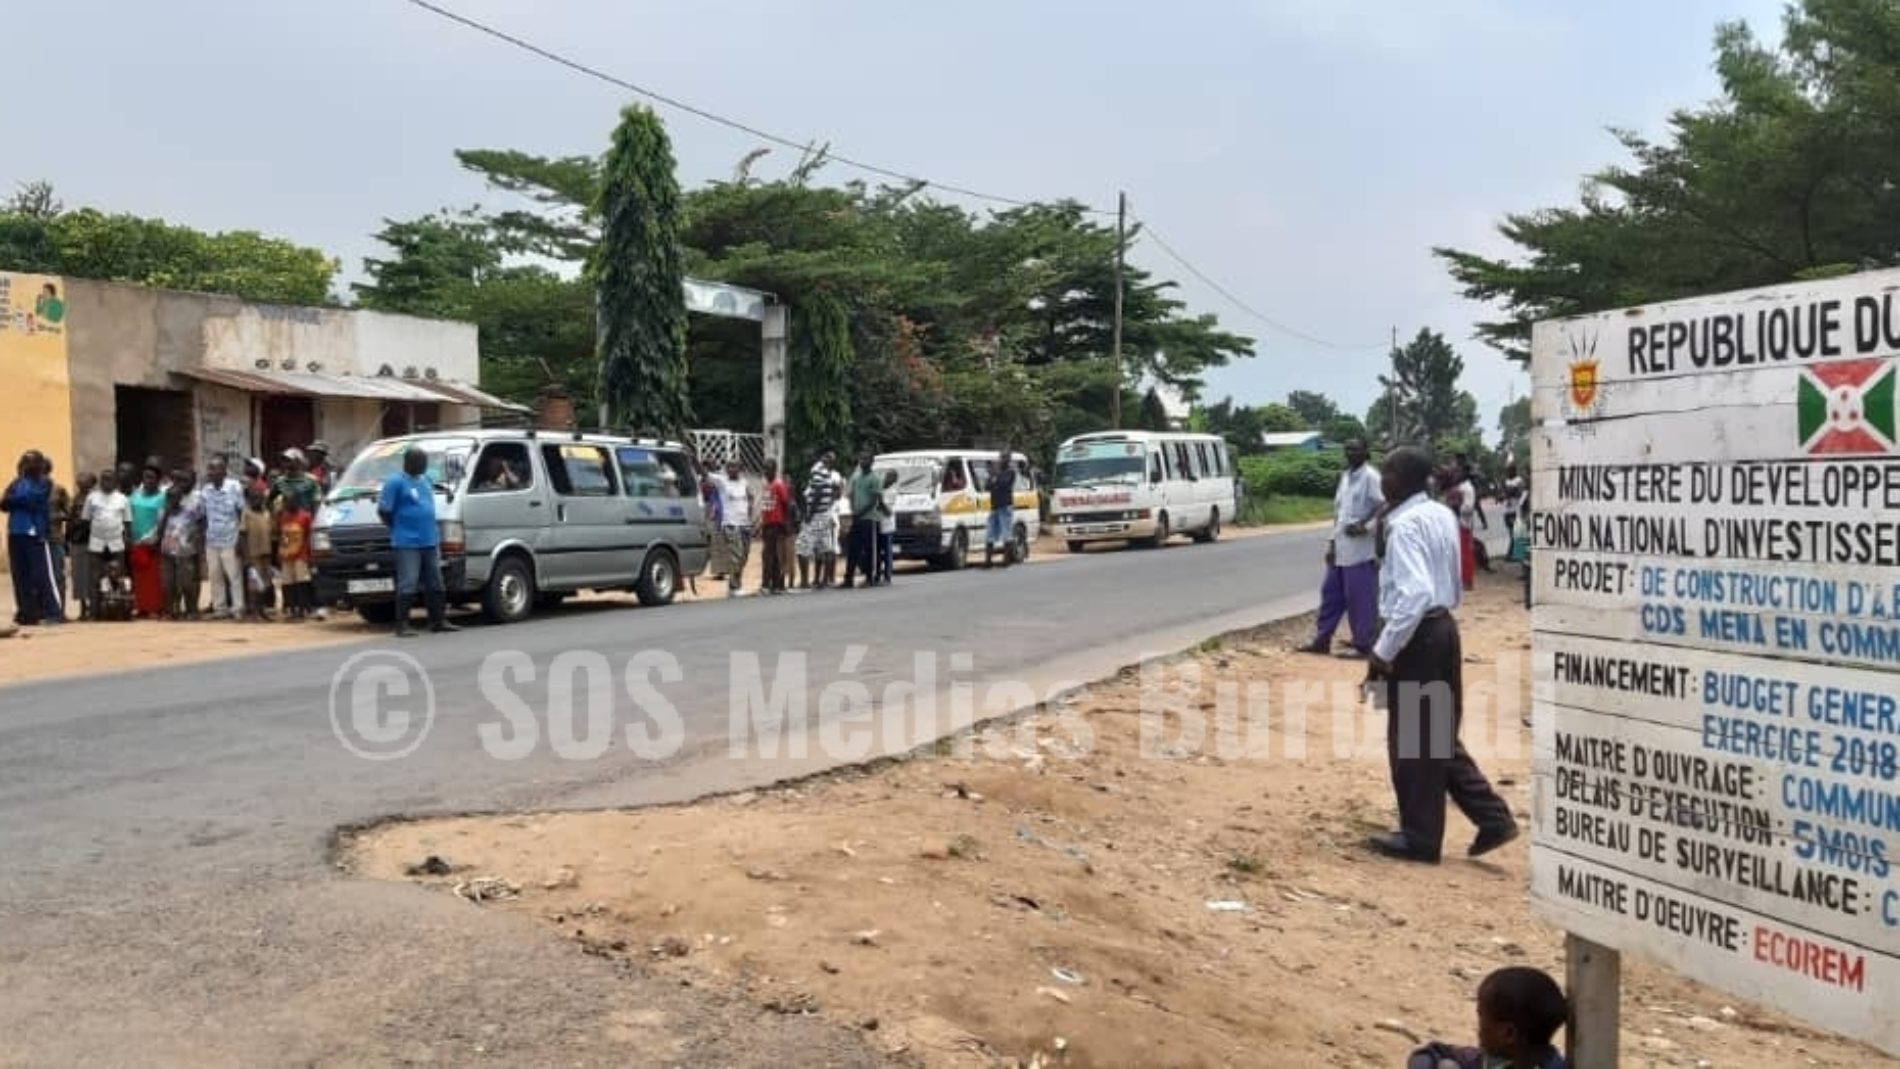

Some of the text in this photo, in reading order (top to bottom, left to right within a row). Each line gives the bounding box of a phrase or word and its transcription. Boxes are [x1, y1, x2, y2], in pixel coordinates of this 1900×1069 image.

[1628, 293, 1900, 374] REPUBLIQUE DU
[1559, 464, 1900, 509] MINISTERE DU DEVELOPPE
[1532, 512, 1900, 567] FOND NATIONAL D'INVESTISSE
[1555, 558, 1635, 595] PROJET:
[1641, 566, 1666, 597] DE
[1675, 569, 1837, 613] CONSTRUCTION
[1642, 604, 1900, 663] CDS MENA EN COMM
[1554, 651, 1900, 735] FINANCEMENT: BUDGET GENER
[1555, 732, 1626, 774] MAITRE
[1633, 744, 1765, 799] D'OUVRAGE:
[1703, 715, 1897, 781] EXERCICE 2018
[1555, 766, 1621, 811] DELAIS
[1629, 782, 1787, 847] D'EXECUTION:
[1555, 807, 1630, 852] BUREAU
[1638, 828, 1667, 863] DE
[1676, 838, 1871, 916] SURVEILLANCE:
[1558, 864, 1865, 993] MAITRE D'OEUVRE: ECOREM
